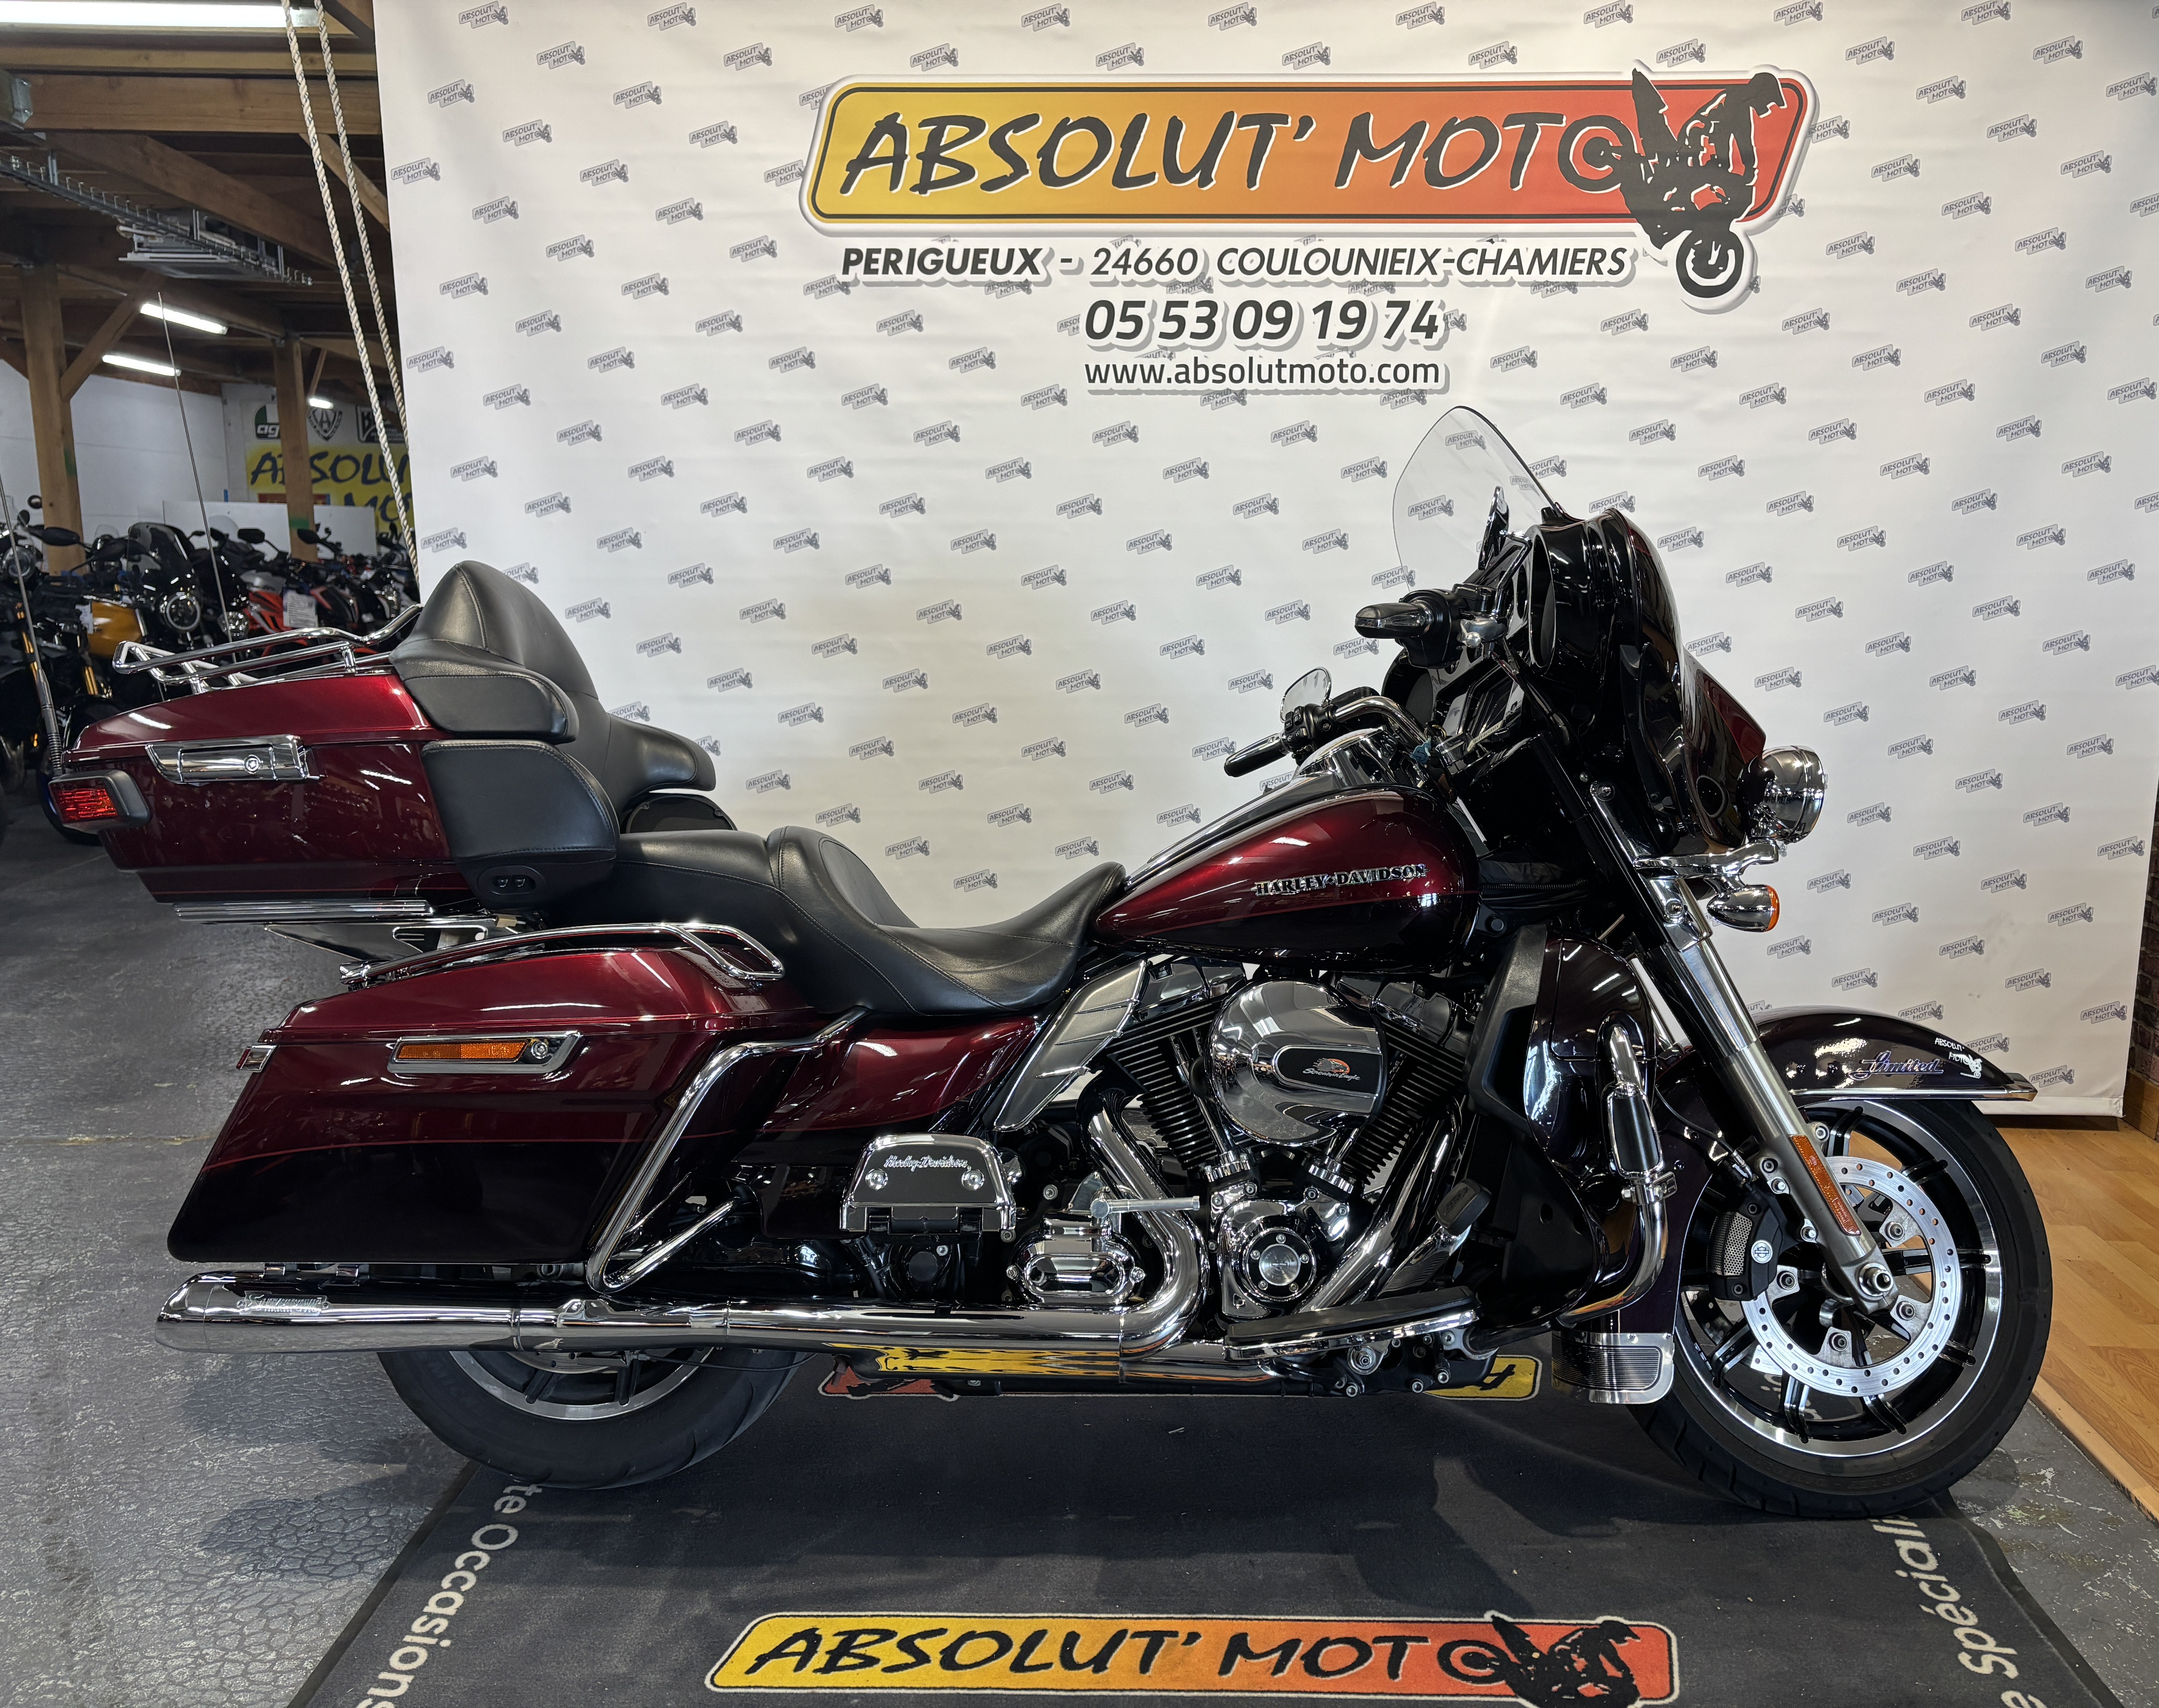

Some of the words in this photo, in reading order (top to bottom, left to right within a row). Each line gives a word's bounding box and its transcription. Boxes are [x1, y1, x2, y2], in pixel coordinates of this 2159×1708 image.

[840, 112, 1314, 195] ABSOLUT'
[842, 248, 1042, 275] PERIGUEUX
[1091, 248, 1198, 275] 24660
[1217, 248, 1627, 275] COULOUNIEIX-CHAMIERS
[1085, 300, 1145, 340] 05
[1159, 300, 1217, 340] 53
[1233, 300, 1292, 340] 09
[1313, 300, 1366, 340] 19
[1384, 300, 1438, 340] 74
[1085, 356, 1439, 384] www.absolutmoto.com
[257, 424, 280, 439] ag
[1848, 1050, 1944, 1080] Limited
[1868, 1515, 2019, 1679] Spéciali
[745, 1627, 1202, 1675] ABSOLUT'
